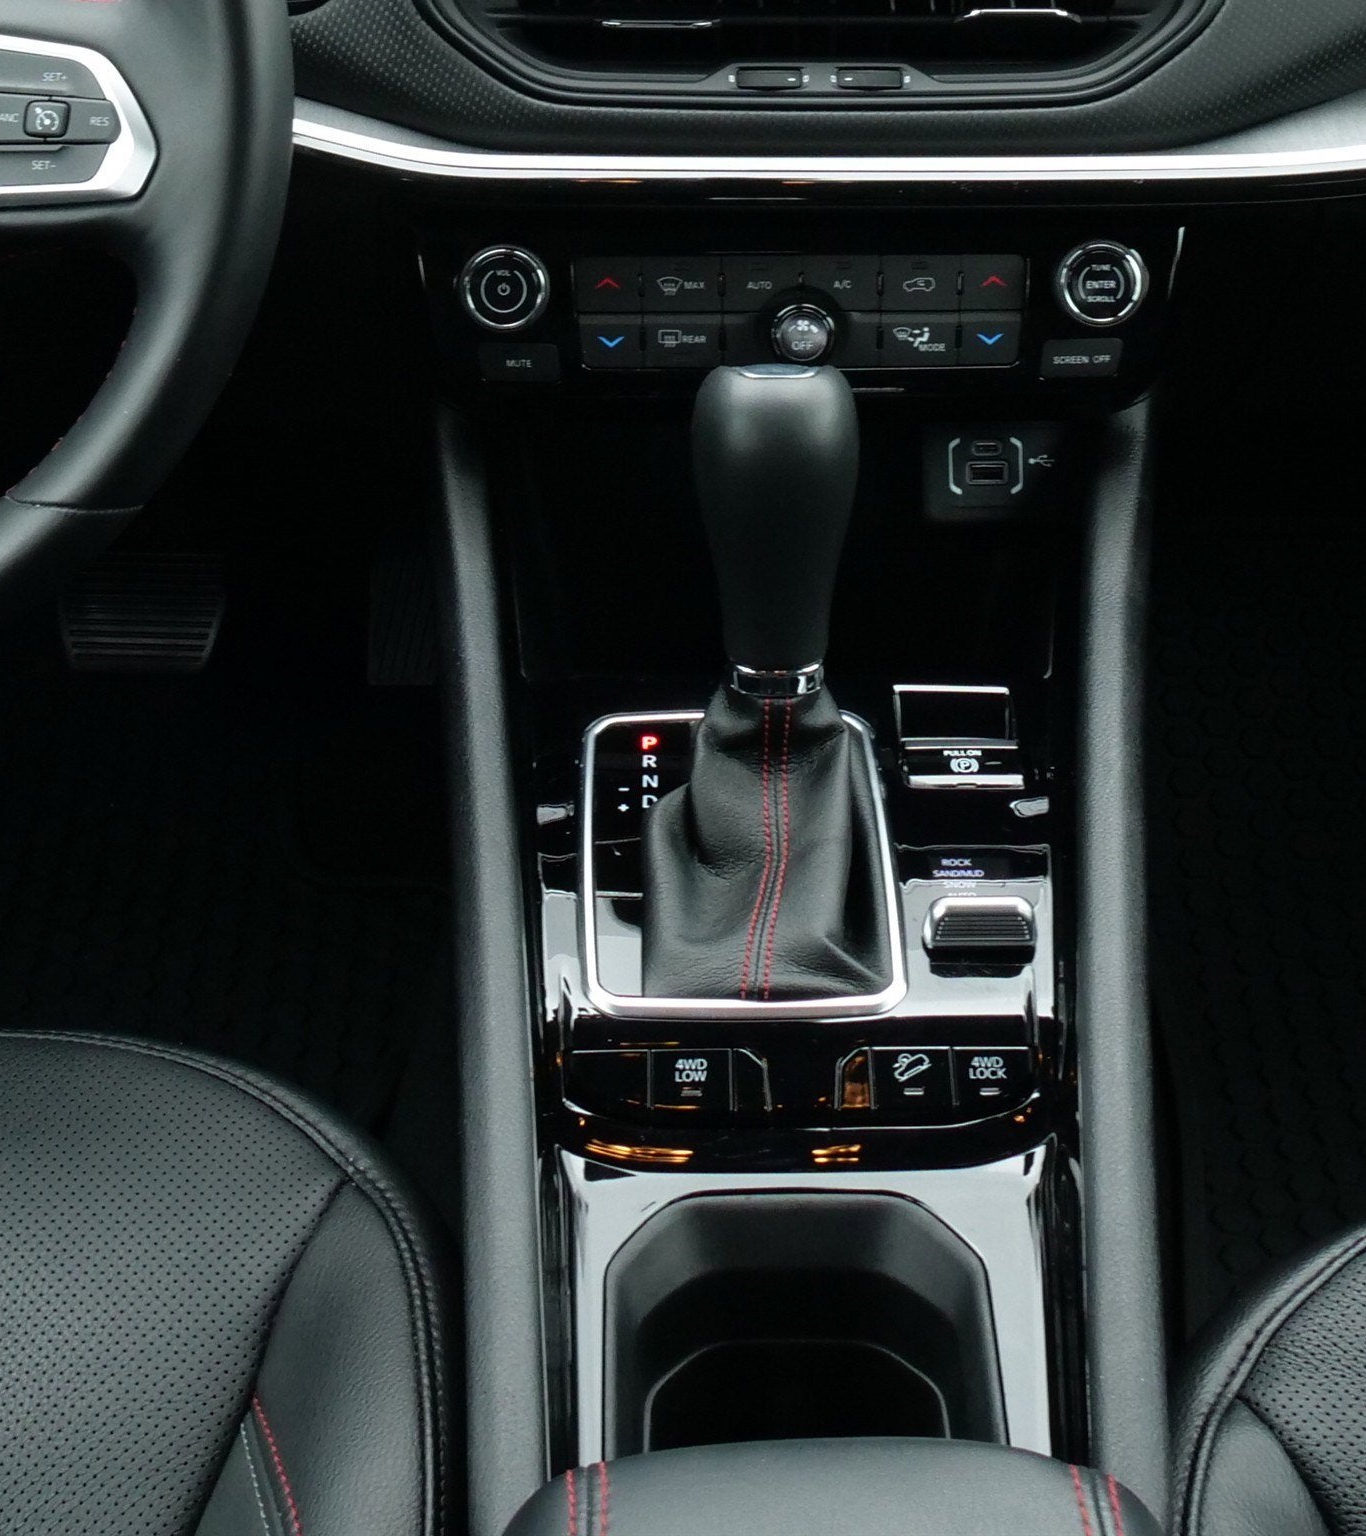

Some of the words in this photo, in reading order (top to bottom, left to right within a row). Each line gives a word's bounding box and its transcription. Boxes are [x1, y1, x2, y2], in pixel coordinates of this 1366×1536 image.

[89, 116, 110, 126] RES
[684, 281, 705, 290] MAX
[746, 280, 773, 290] AUTO
[833, 280, 852, 289] A/C
[1086, 280, 1116, 289] ENTER
[1087, 295, 1115, 303] SCROLL
[682, 335, 707, 344] REAR
[792, 341, 813, 351] OFF
[919, 343, 946, 352] MODE
[506, 359, 532, 368] MUTE
[1053, 356, 1090, 364] SCREEN
[1092, 354, 1111, 363] OFF
[642, 735, 658, 750] P
[642, 754, 657, 768] R
[642, 775, 659, 788] N
[642, 794, 658, 809] D
[941, 859, 972, 867] ROCK
[675, 1058, 708, 1070] 4WD
[970, 1056, 1004, 1068] 4WD
[675, 1070, 708, 1083] LOW
[968, 1067, 1007, 1080] LOCK
